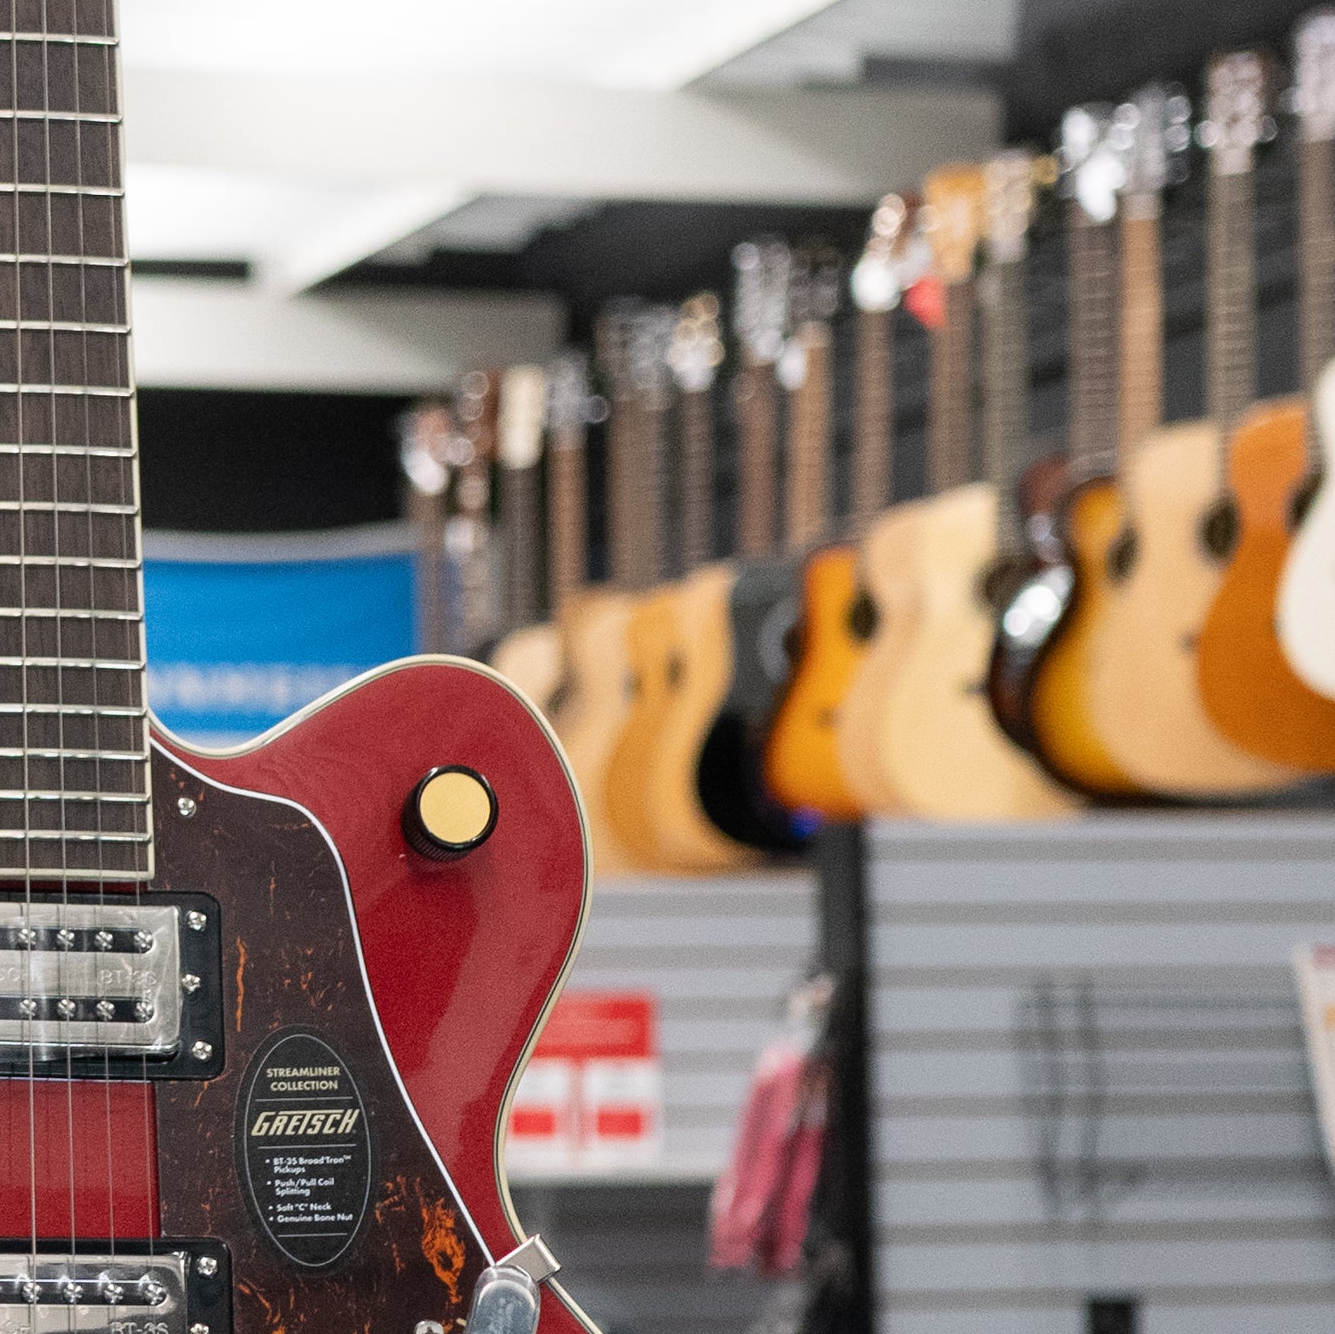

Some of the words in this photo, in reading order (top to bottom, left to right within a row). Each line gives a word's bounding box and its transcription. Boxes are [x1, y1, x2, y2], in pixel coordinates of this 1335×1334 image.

[266, 1066, 341, 1078] STREAMLINER
[270, 1079, 339, 1092] COLLECTION
[251, 1108, 360, 1136] GRETSCH
[273, 1165, 306, 1175] Pickups
[275, 1178, 317, 1187] Push/Pull
[317, 1177, 335, 1186] Coil
[275, 1187, 311, 1197] Splitting
[276, 1203, 294, 1212] Soft
[309, 1202, 332, 1211] Neck
[277, 1214, 313, 1223] Genuine
[314, 1213, 336, 1222] Bone
[336, 1213, 353, 1221] Nut
